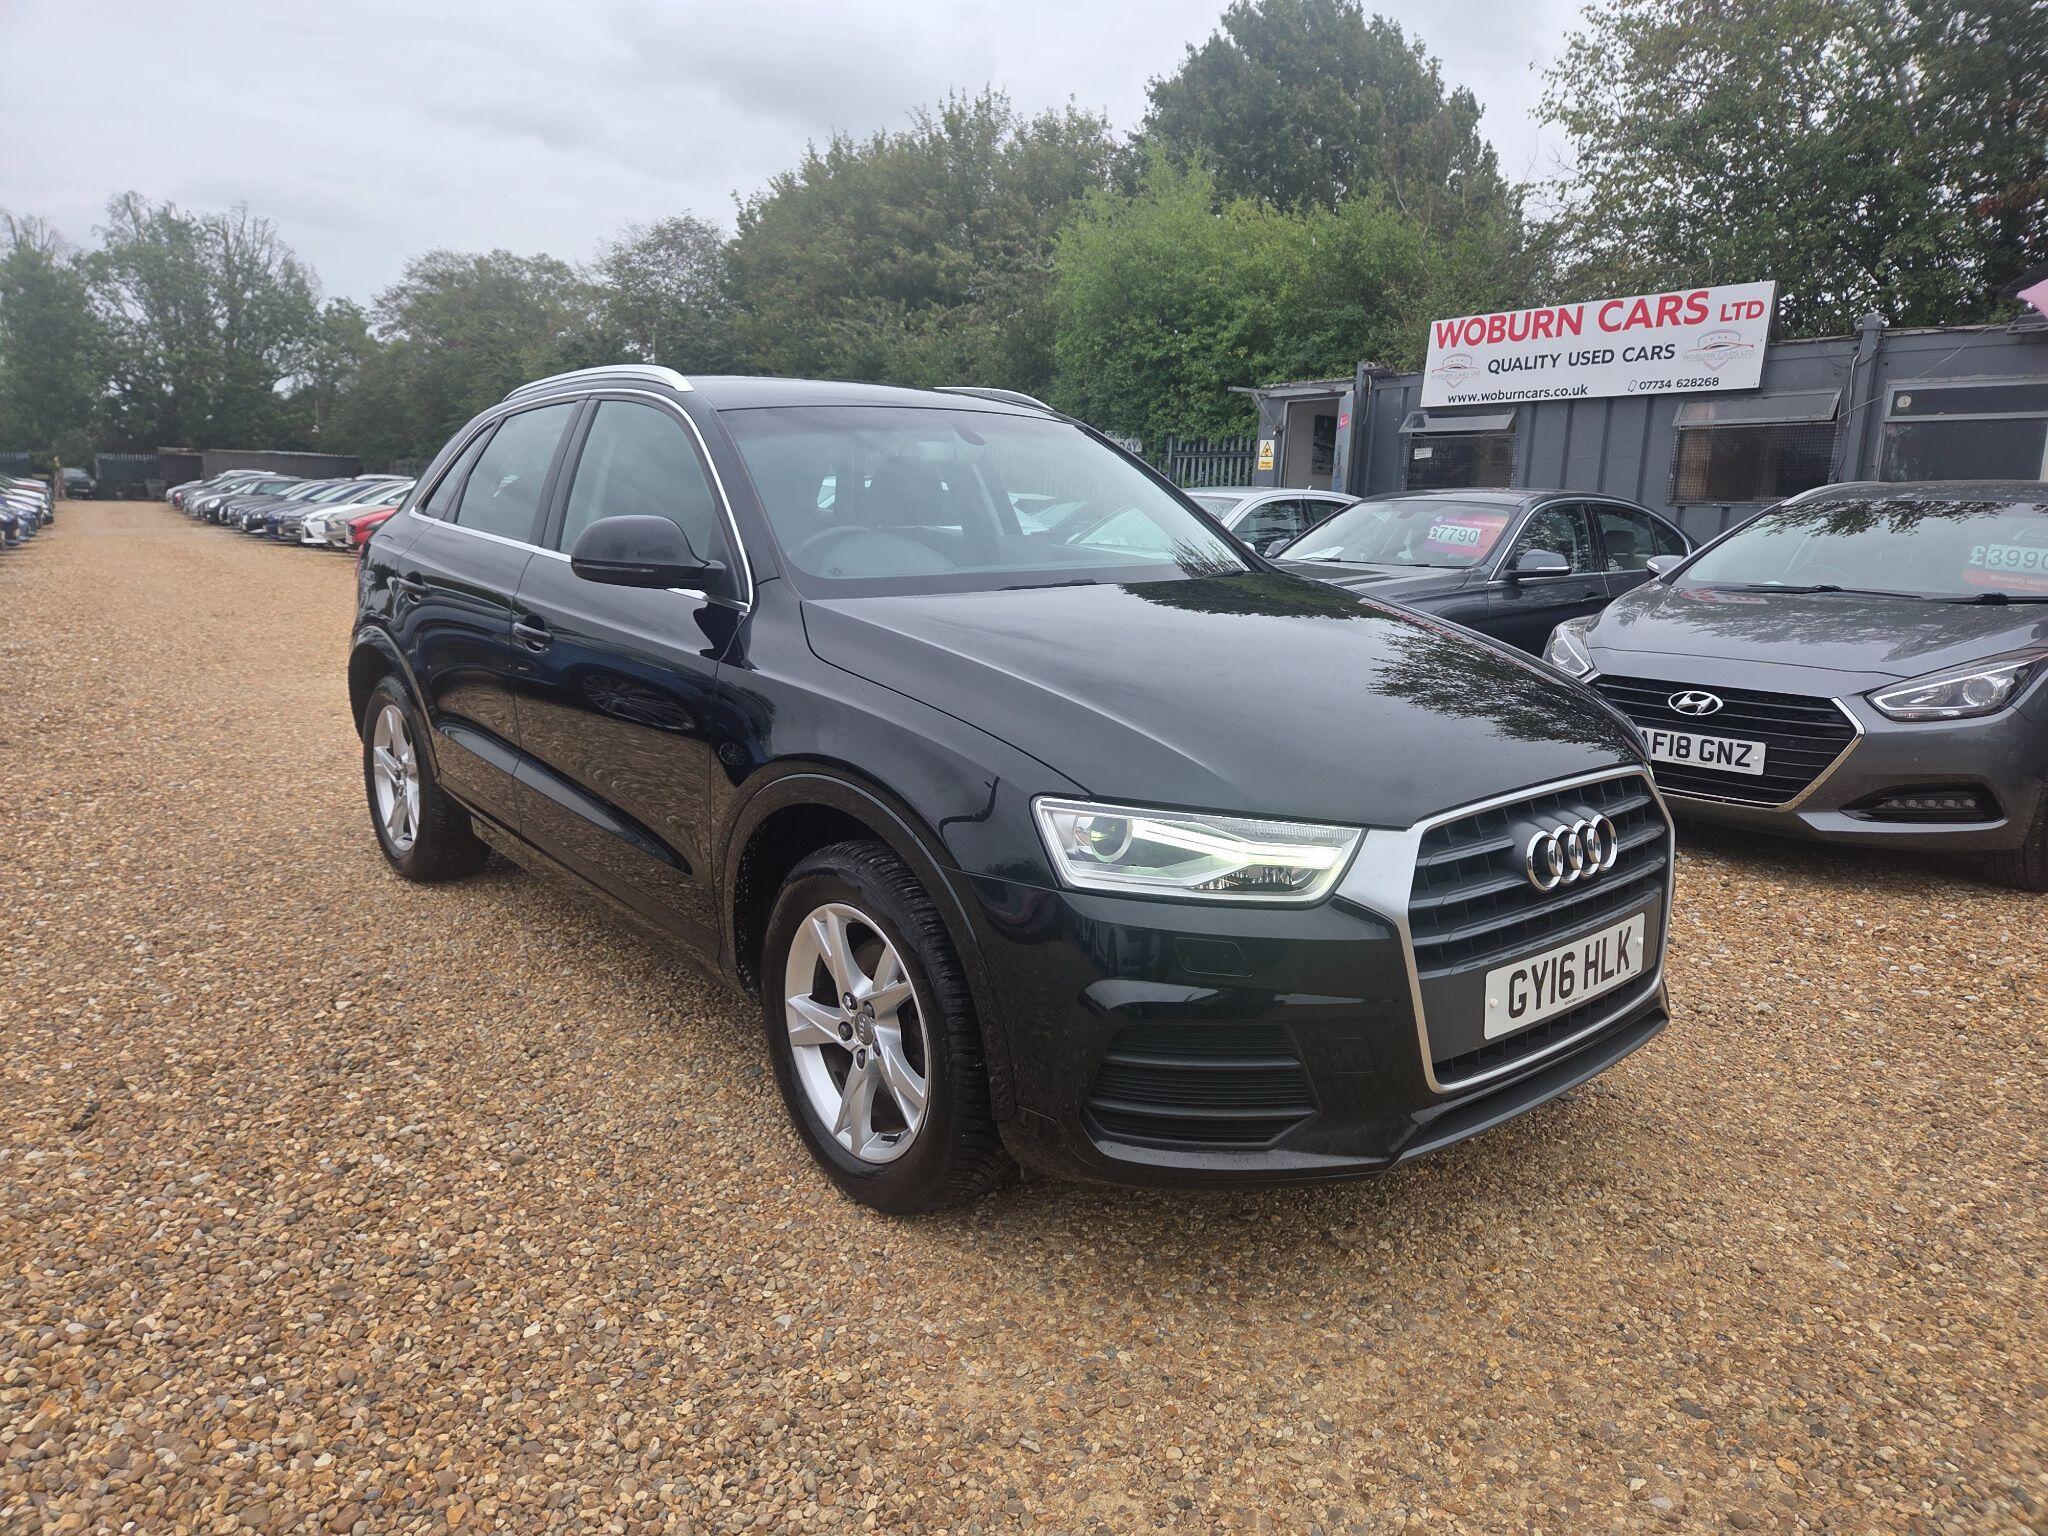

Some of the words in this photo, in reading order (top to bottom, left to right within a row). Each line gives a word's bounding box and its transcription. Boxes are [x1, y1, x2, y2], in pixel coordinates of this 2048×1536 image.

[1436, 305, 1584, 349] WOBURN
[1598, 291, 1709, 332] CARS
[1720, 300, 1765, 322] LTD
[1488, 353, 1562, 375] QUALITY
[1568, 349, 1615, 367] USED
[1622, 343, 1676, 363] CARS
[1448, 384, 1588, 403] www.woburncars.co.uk
[1639, 379, 1672, 390] 07734
[1676, 377, 1720, 388] 628268
[1427, 525, 1479, 543] £7790
[1699, 738, 1752, 768] GNZ
[1508, 951, 1576, 1019] GY16
[1583, 926, 1632, 989] HLK
